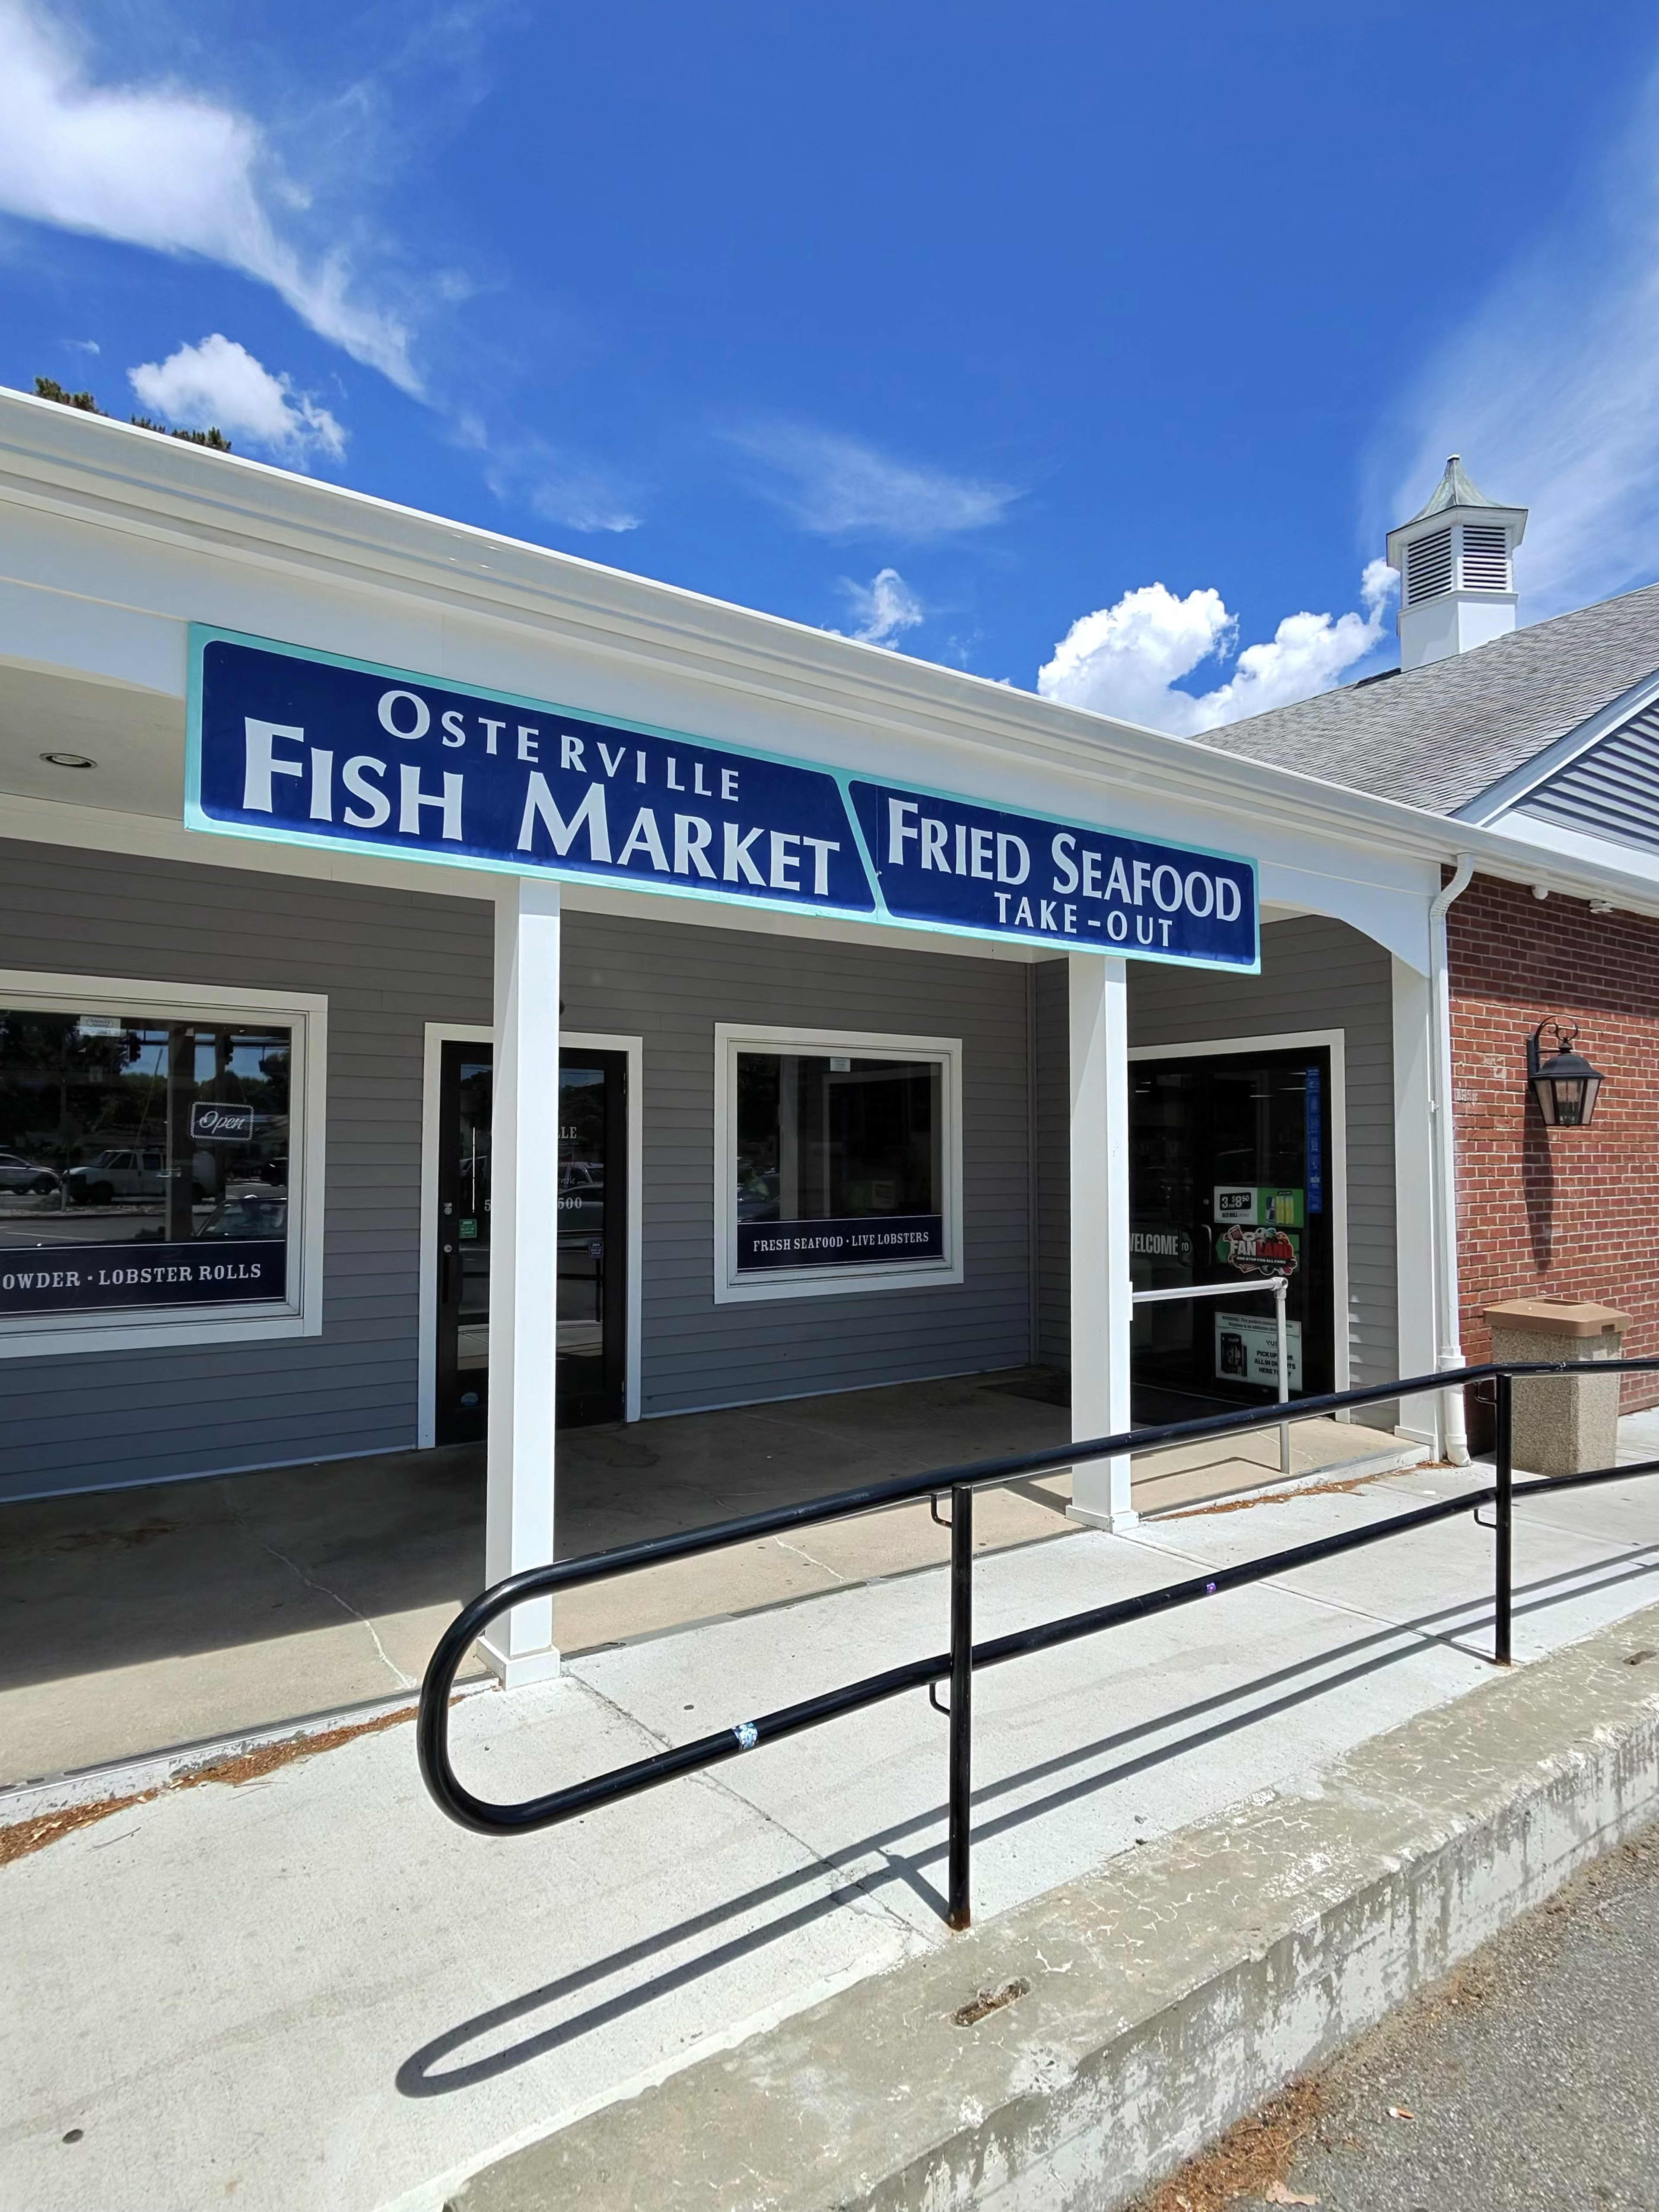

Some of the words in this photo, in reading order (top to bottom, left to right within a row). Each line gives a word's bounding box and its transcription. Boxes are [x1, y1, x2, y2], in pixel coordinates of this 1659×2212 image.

[378, 690, 738, 801] OSTERVILLE
[243, 717, 463, 841] FISH
[517, 771, 840, 896] MARKET
[888, 798, 1030, 885] FRIED
[1052, 833, 1241, 922] SEAFOOD
[995, 892, 1173, 947] TAKE-OUT
[199, 1111, 245, 1134] Open
[1222, 1196, 1228, 1208] 3
[753, 1239, 791, 1252] FRESH
[794, 1236, 843, 1249] SEAFOOD
[852, 1234, 875, 1246] LIVE
[877, 1232, 929, 1244] LOBSTERS
[0, 1271, 80, 1290] OWDER
[99, 1266, 193, 1285] LOBSTER
[199, 1263, 261, 1281] ROLLS
